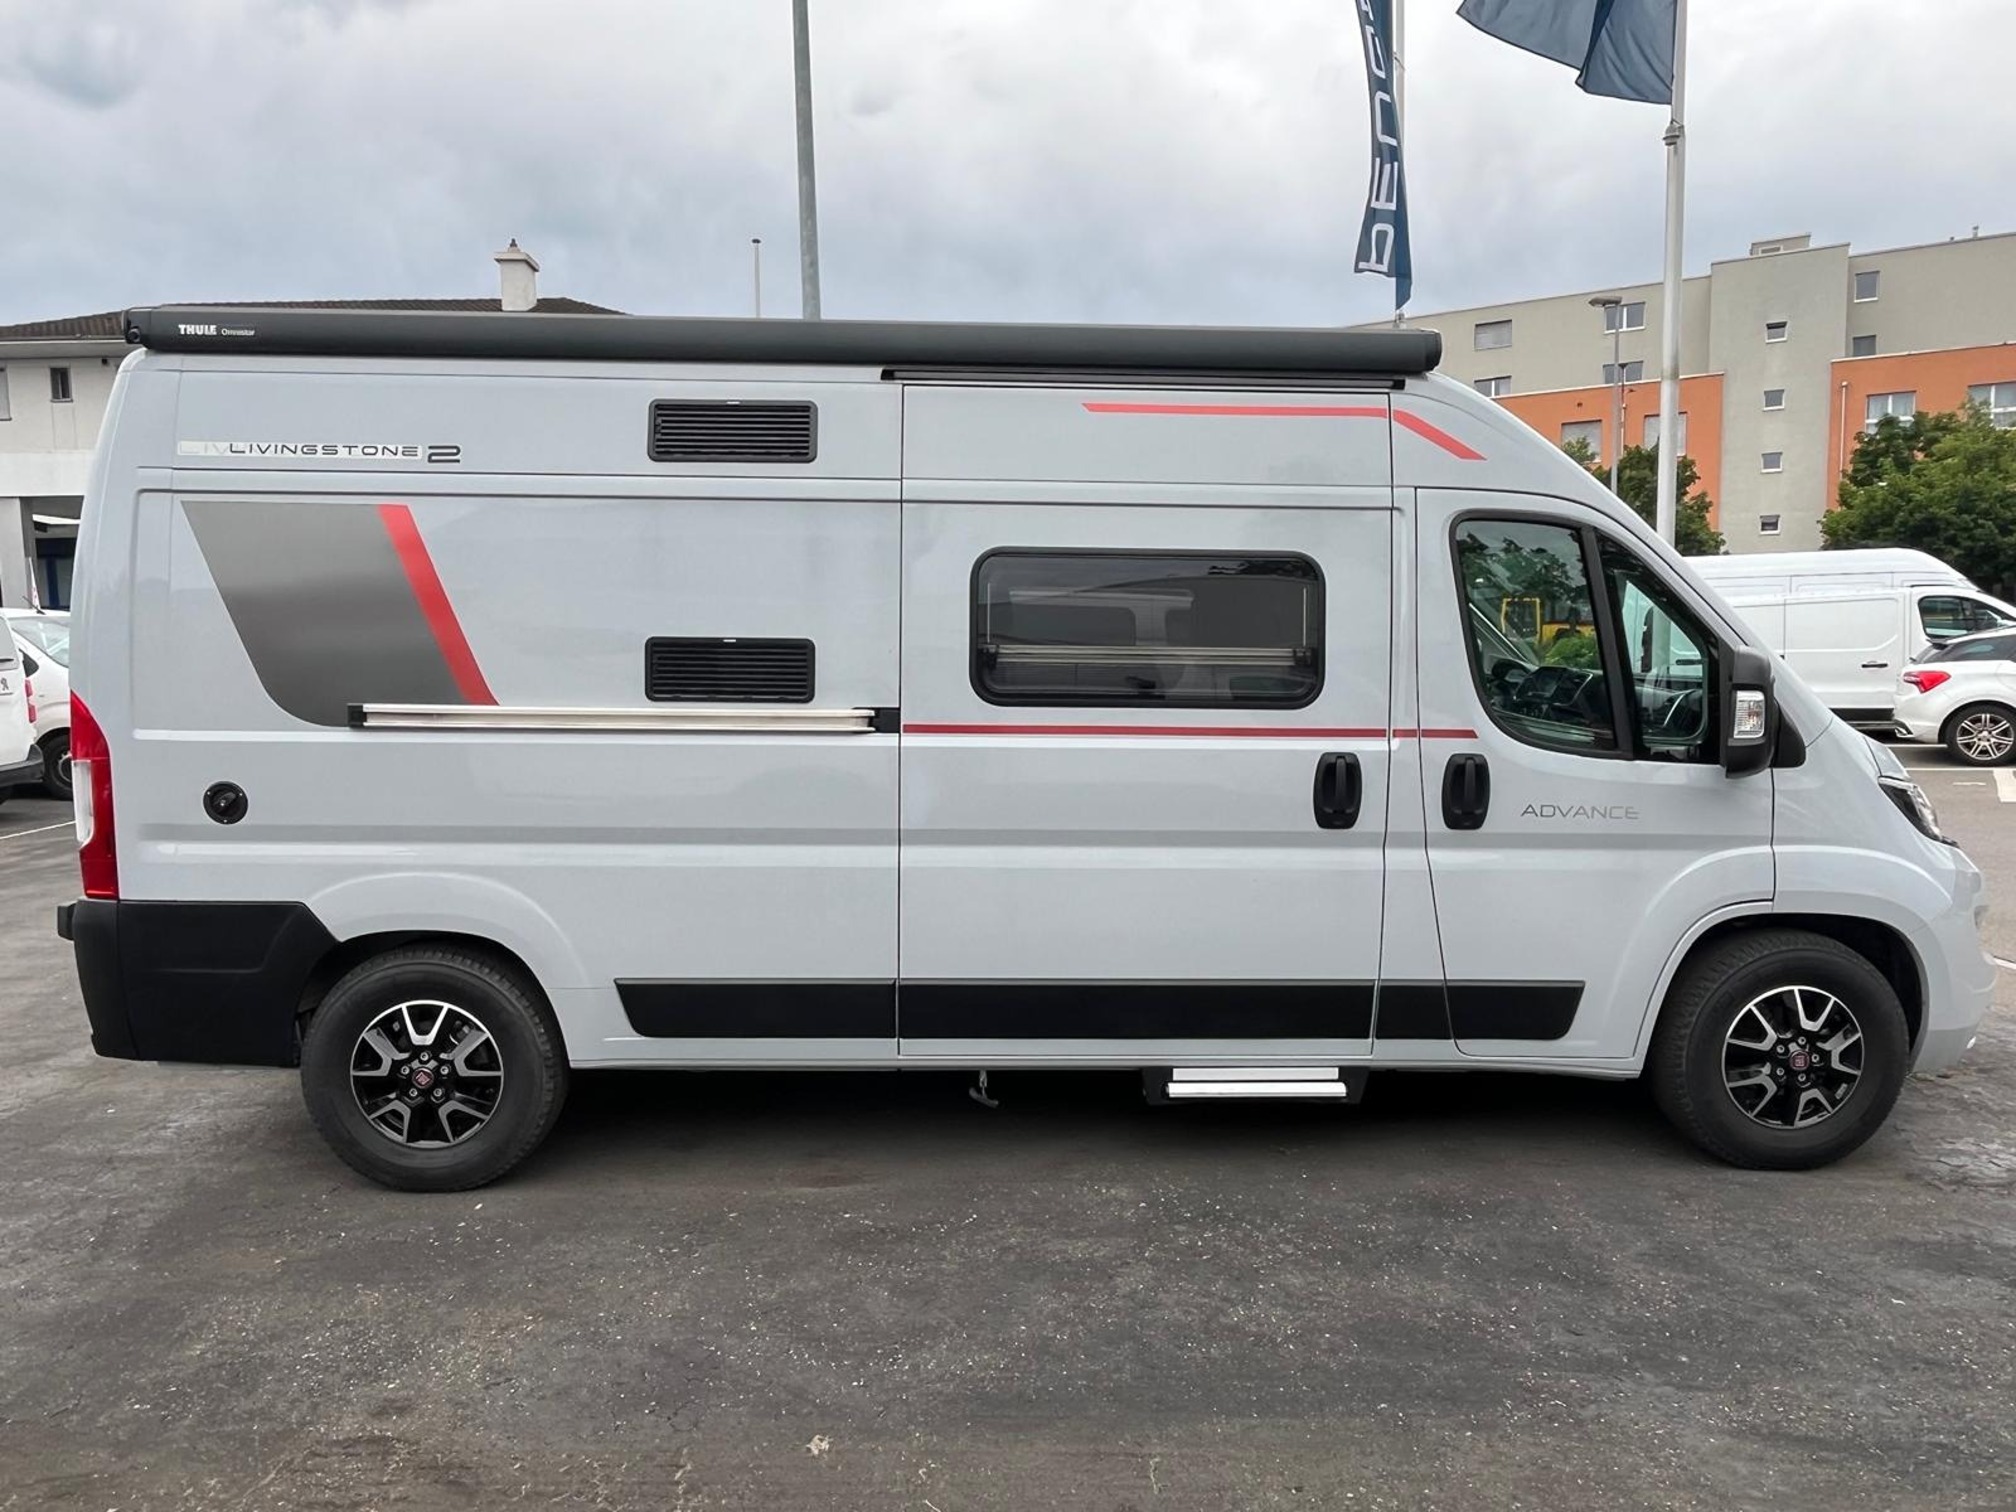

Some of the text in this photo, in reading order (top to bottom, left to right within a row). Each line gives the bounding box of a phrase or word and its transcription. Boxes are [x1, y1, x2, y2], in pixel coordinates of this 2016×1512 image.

[178, 324, 217, 335] THULE
[229, 442, 461, 464] LIVINGSTONE 2
[1520, 804, 1640, 820] ADVANCE
